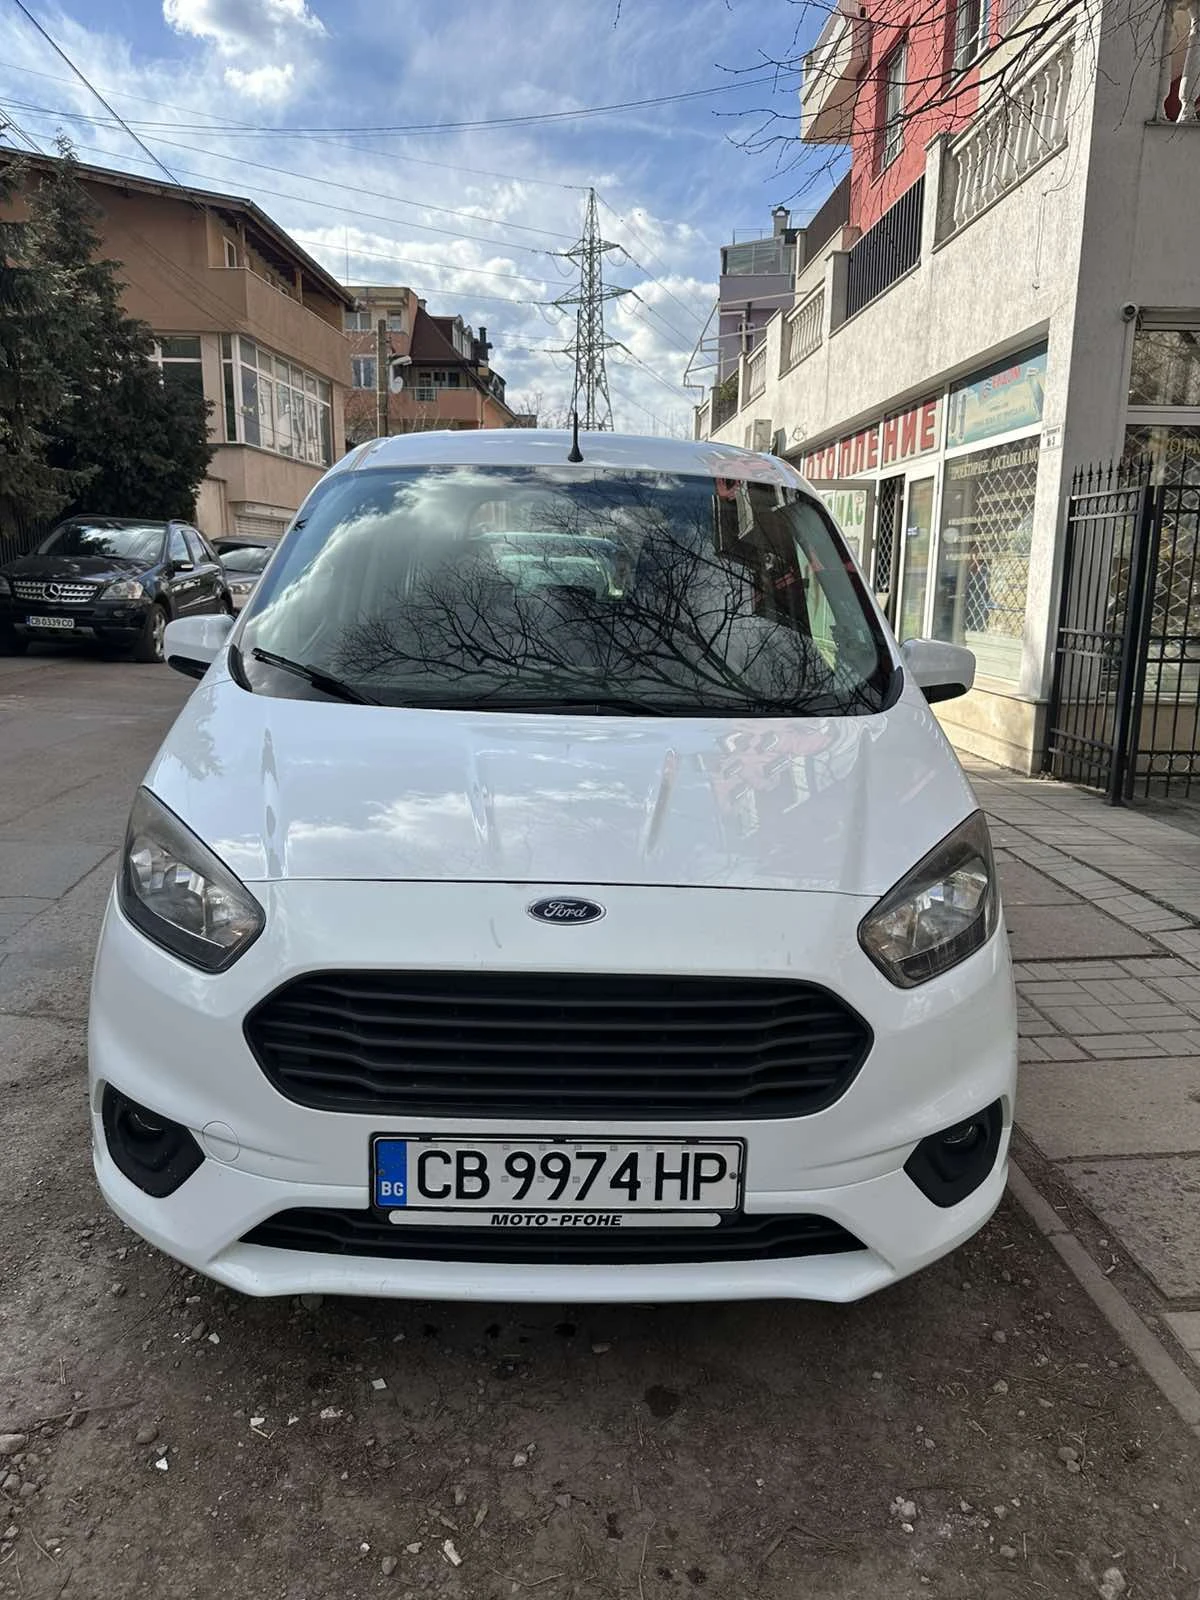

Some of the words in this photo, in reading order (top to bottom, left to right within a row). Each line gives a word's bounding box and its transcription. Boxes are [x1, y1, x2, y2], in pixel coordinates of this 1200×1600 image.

[804, 398, 937, 479] ОТОПЛЕНИЕ
[544, 901, 587, 917] Ford
[381, 1182, 404, 1196] BG
[417, 1150, 490, 1200] CB
[504, 1150, 641, 1202] 9974
[654, 1151, 727, 1201] HP
